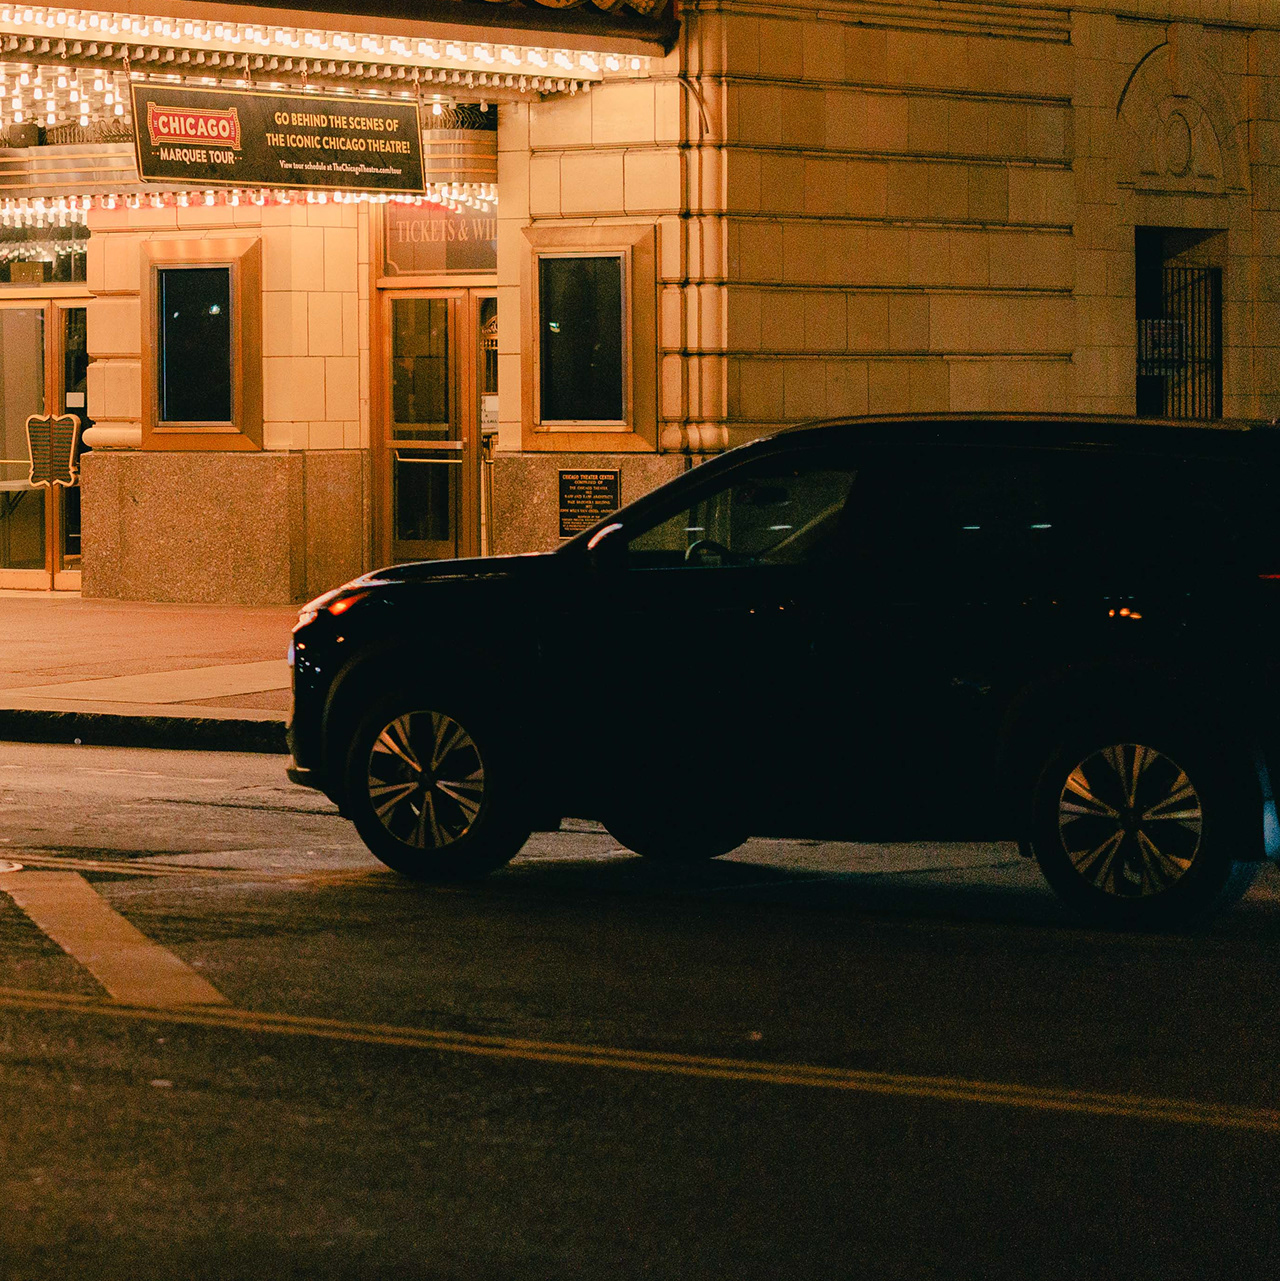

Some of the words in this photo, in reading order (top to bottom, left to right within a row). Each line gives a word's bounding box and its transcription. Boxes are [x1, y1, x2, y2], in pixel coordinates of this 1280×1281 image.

[158, 115, 230, 138] CHICAGO
[274, 111, 289, 125] GO
[291, 113, 328, 127] BEHIND
[329, 115, 348, 129] THE
[349, 117, 384, 131] SCENES
[386, 118, 399, 132] OF
[266, 132, 285, 147] THE
[286, 134, 321, 149] ICONIC
[323, 136, 365, 152] CHICAGO
[366, 139, 411, 154] THEATRE!
[160, 148, 207, 164] MARQUEE
[209, 150, 235, 164] TOUR
[279, 160, 292, 169] View
[304, 162, 326, 171] schedule
[396, 220, 456, 242] TICKETS
[457, 219, 469, 242] &
